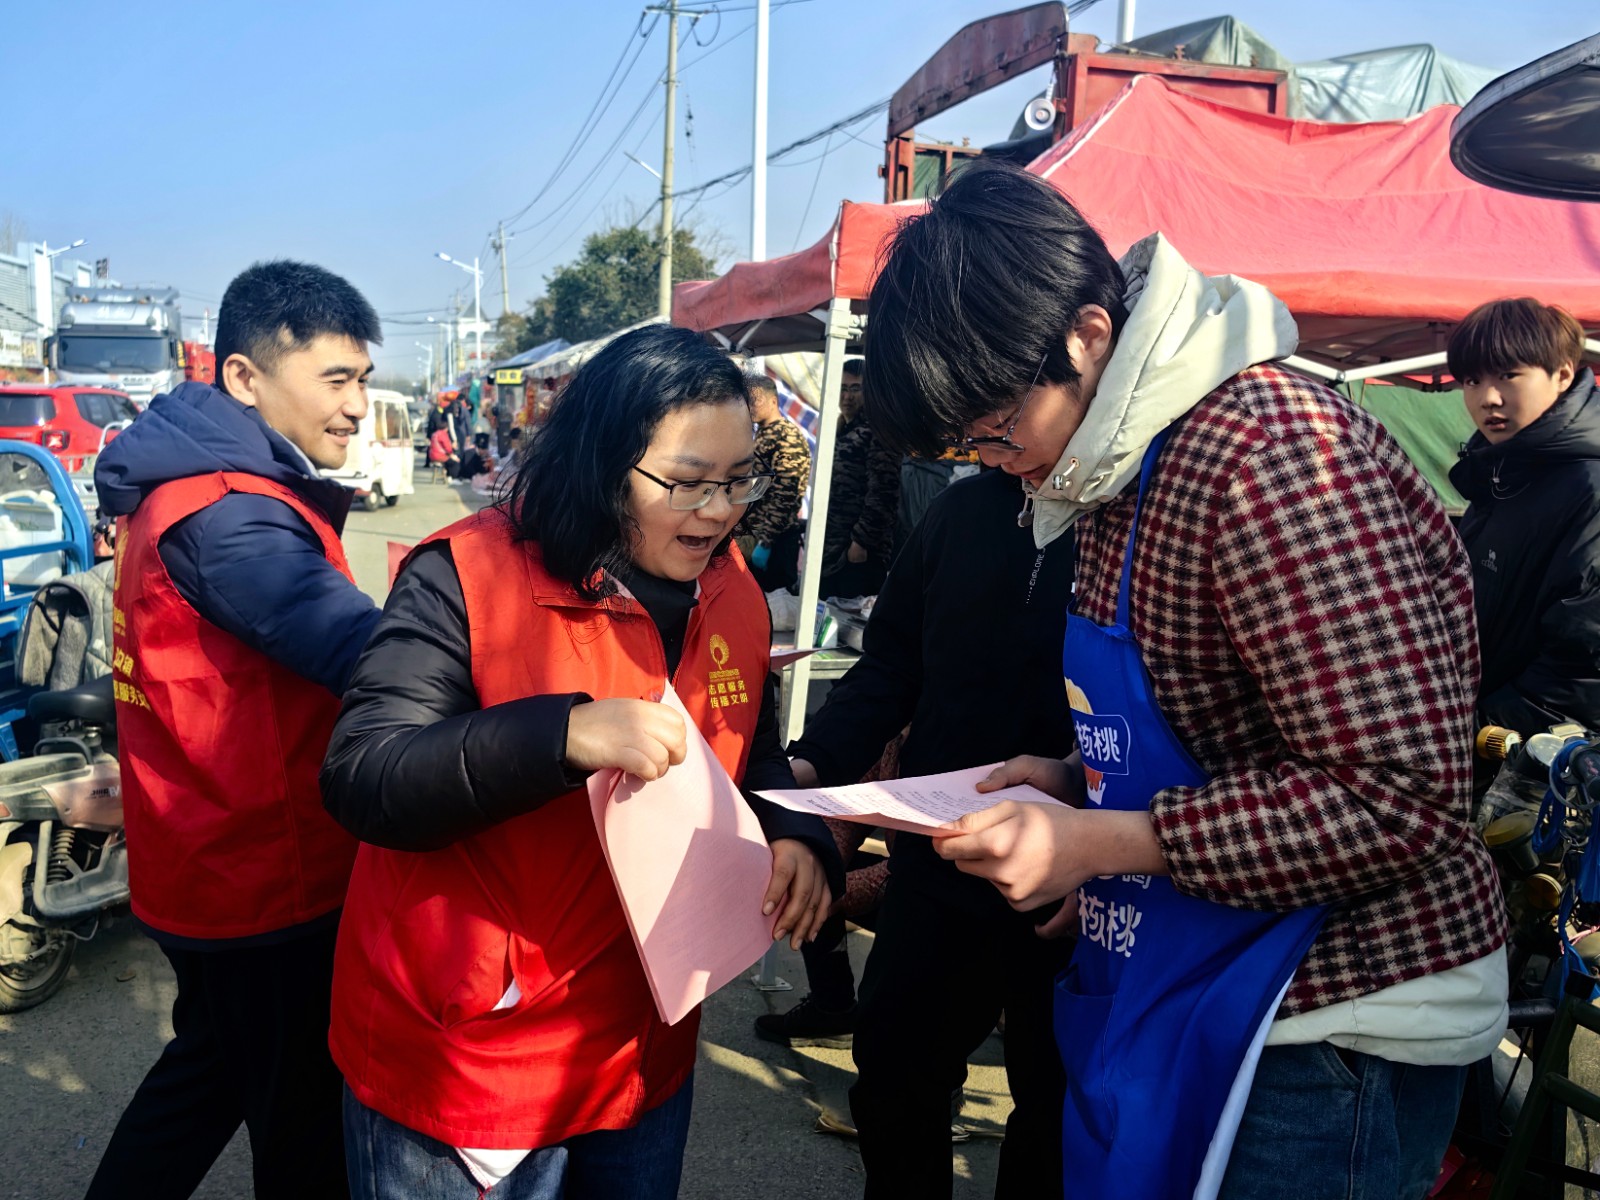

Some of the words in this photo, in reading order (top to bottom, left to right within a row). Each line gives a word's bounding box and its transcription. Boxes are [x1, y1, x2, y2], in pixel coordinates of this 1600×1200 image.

[708, 680, 746, 695] 志愿服务
[710, 692, 749, 709] 传播文明
